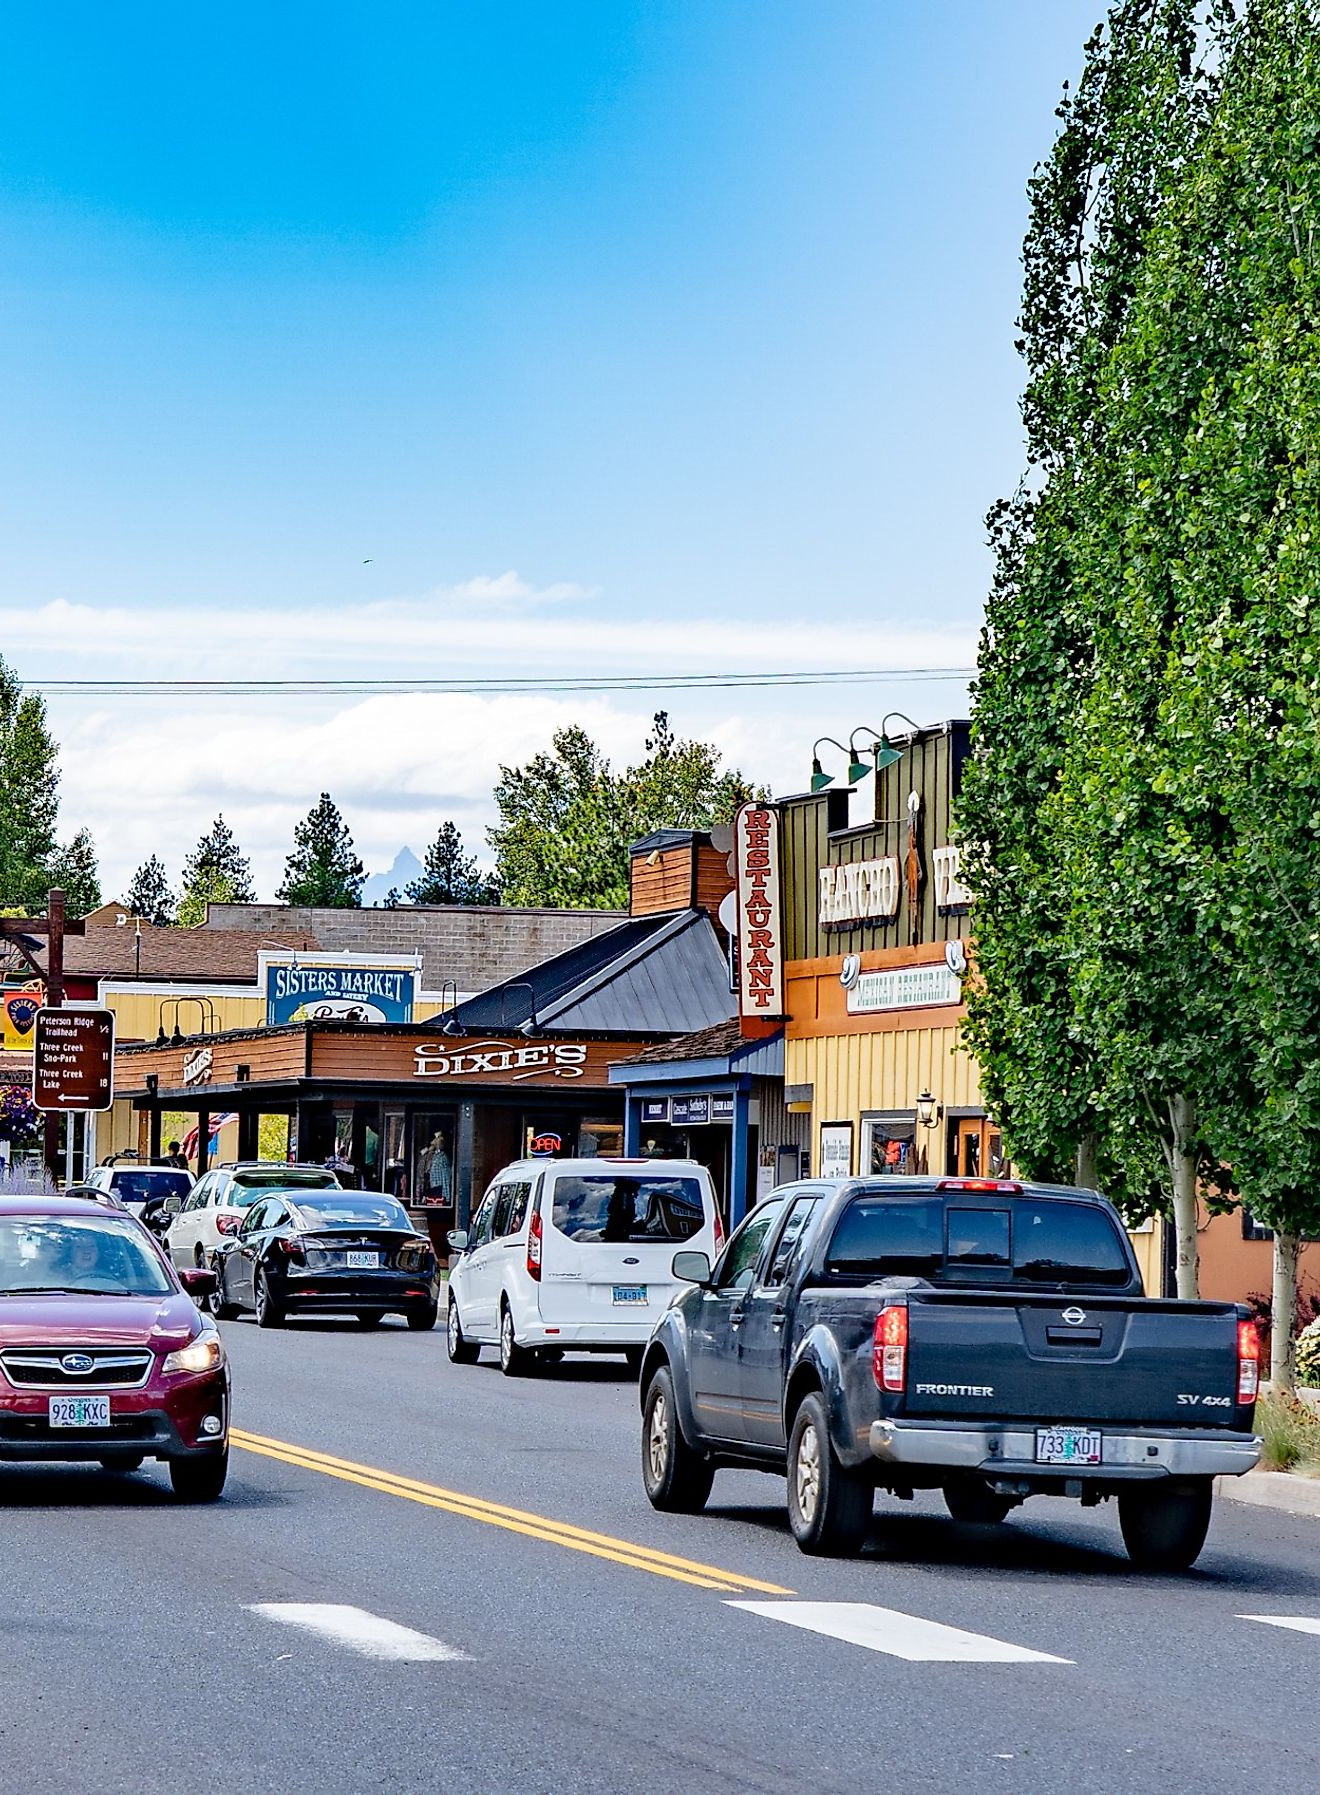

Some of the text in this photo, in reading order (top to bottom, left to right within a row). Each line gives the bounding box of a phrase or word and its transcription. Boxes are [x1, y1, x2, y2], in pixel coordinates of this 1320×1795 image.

[819, 857, 900, 924] RANCHO
[744, 810, 775, 1007] RESTAURANT
[276, 970, 404, 1002] SISTERS MARKET
[40, 1016, 71, 1026] Peterson
[74, 1017, 95, 1028] Ridge
[45, 1028, 78, 1037] Trailhead
[40, 1043, 84, 1052] Three Creek
[44, 1052, 109, 1062] Sno-Park 11
[413, 1044, 587, 1076] DIXIE'S
[39, 1069, 83, 1078] Three Creek
[43, 1079, 108, 1089] Lake 18
[529, 1138, 561, 1151] OPEN
[916, 1384, 994, 1397] FRONTIER
[1176, 1394, 1200, 1405] SV
[52, 1403, 107, 1420] 928 KXC
[1038, 1435, 1099, 1455] 733 KDT
